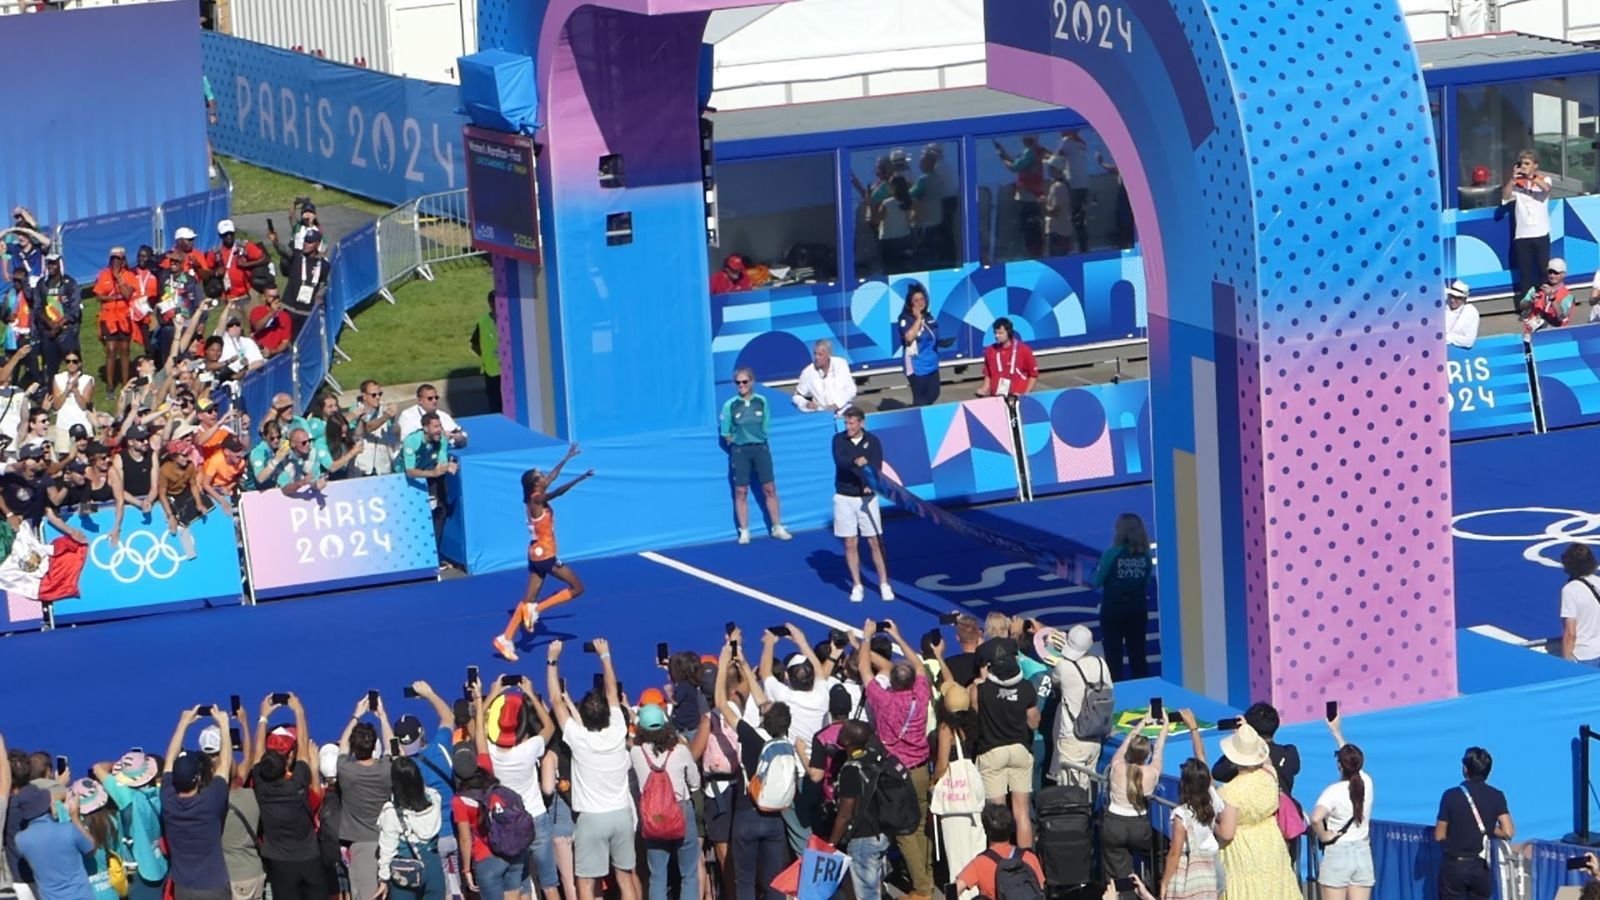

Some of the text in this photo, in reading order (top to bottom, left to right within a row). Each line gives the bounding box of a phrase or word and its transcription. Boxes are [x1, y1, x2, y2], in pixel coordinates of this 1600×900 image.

[1053, 0, 1132, 53] 2024
[349, 105, 455, 188] 2024
[1446, 357, 1490, 384] RiS
[296, 528, 392, 564] 2024
